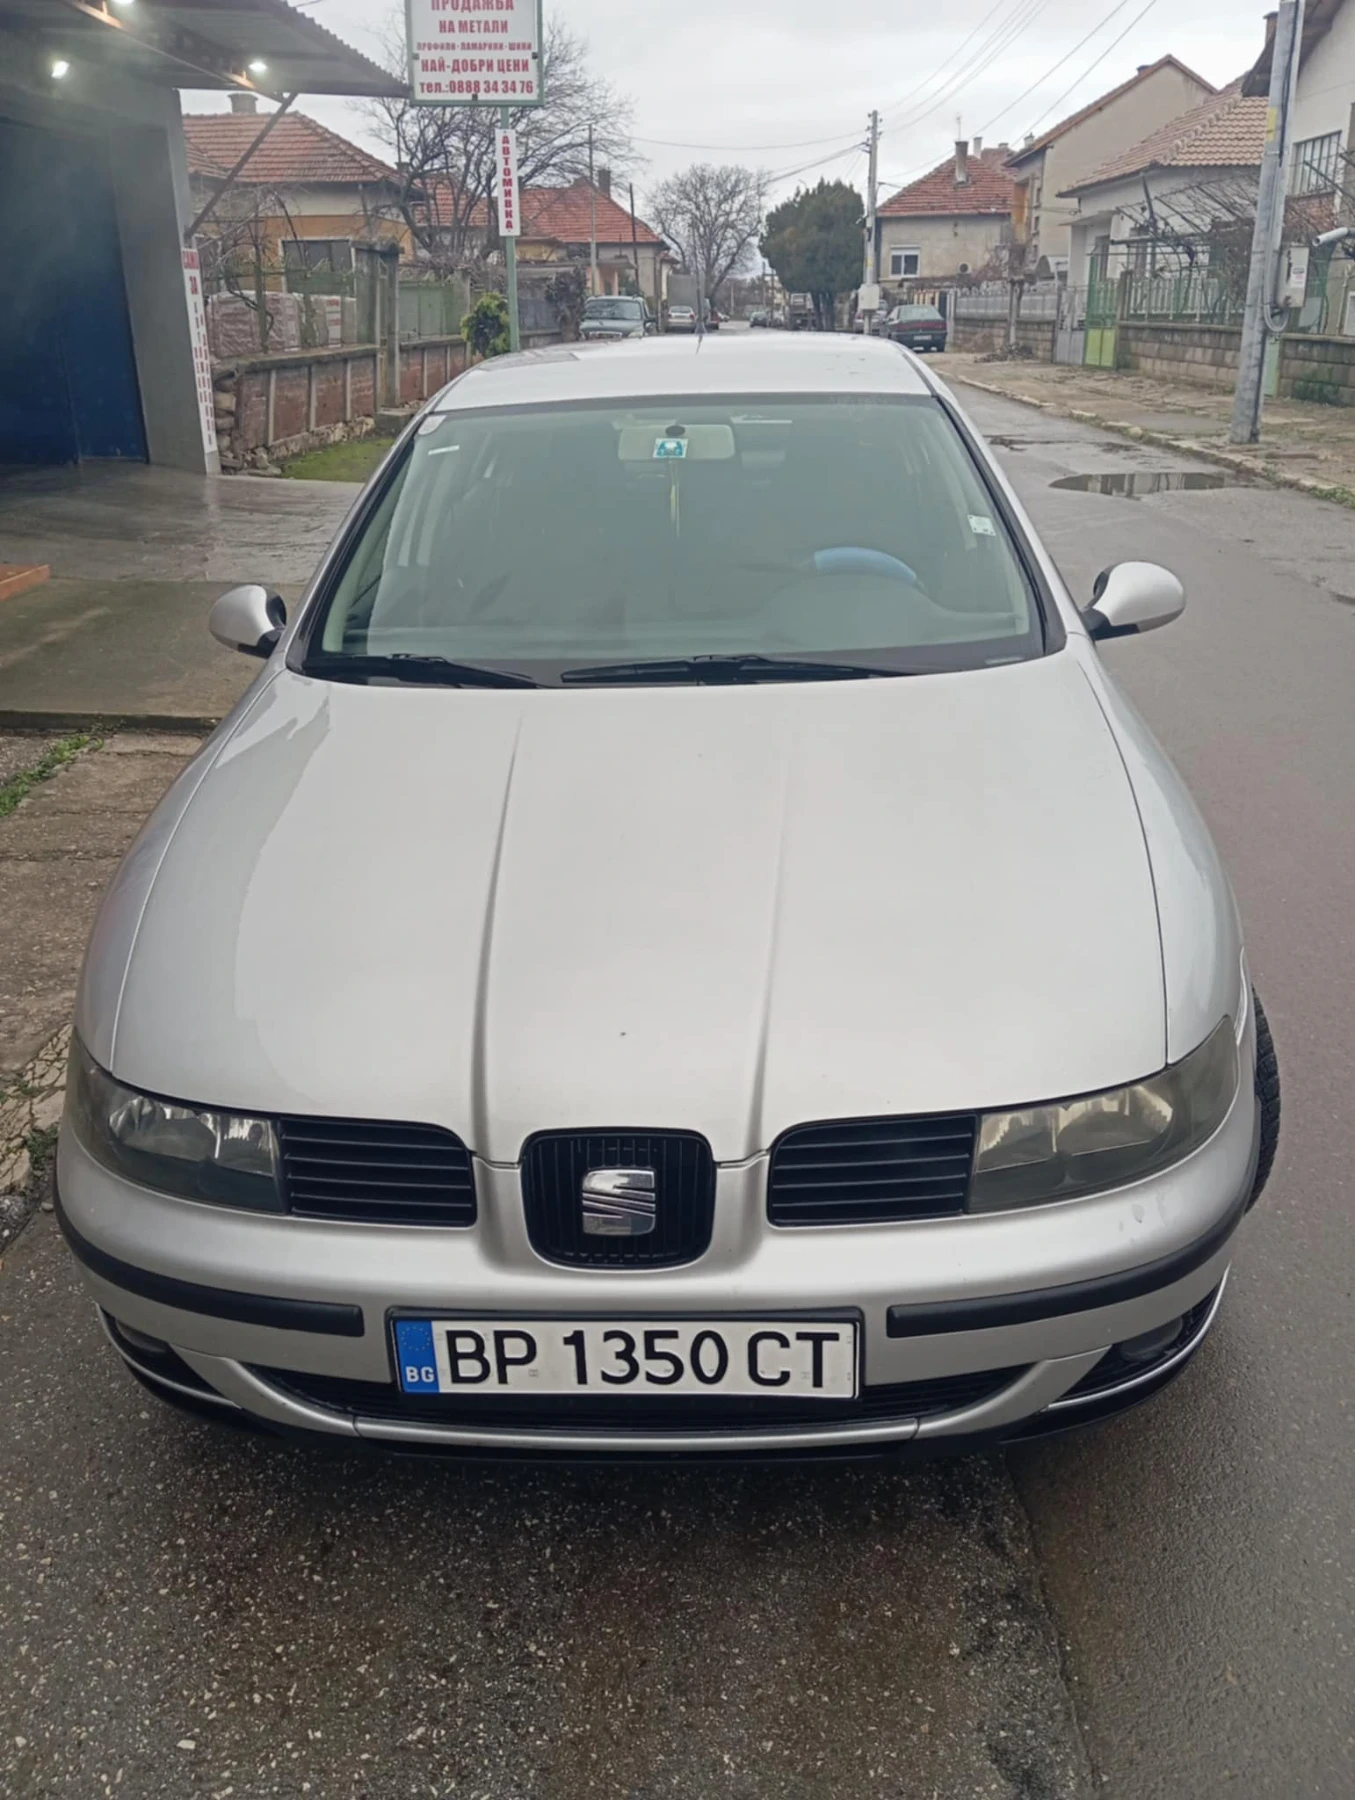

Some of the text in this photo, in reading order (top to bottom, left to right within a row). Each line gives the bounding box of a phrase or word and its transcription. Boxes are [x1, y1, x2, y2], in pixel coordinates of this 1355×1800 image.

[431, 0, 514, 12] ПРОДАЖБА
[439, 20, 508, 33] НА МЕТАЛИ
[421, 57, 529, 73] НАЙ-ДОБРИ ЦЕНИ
[483, 80, 499, 94] 34
[501, 80, 517, 94] 34
[519, 80, 534, 94] 76
[502, 135, 513, 229] АВТОМИВКА
[405, 1329, 840, 1388] BG BP 1350 CT
